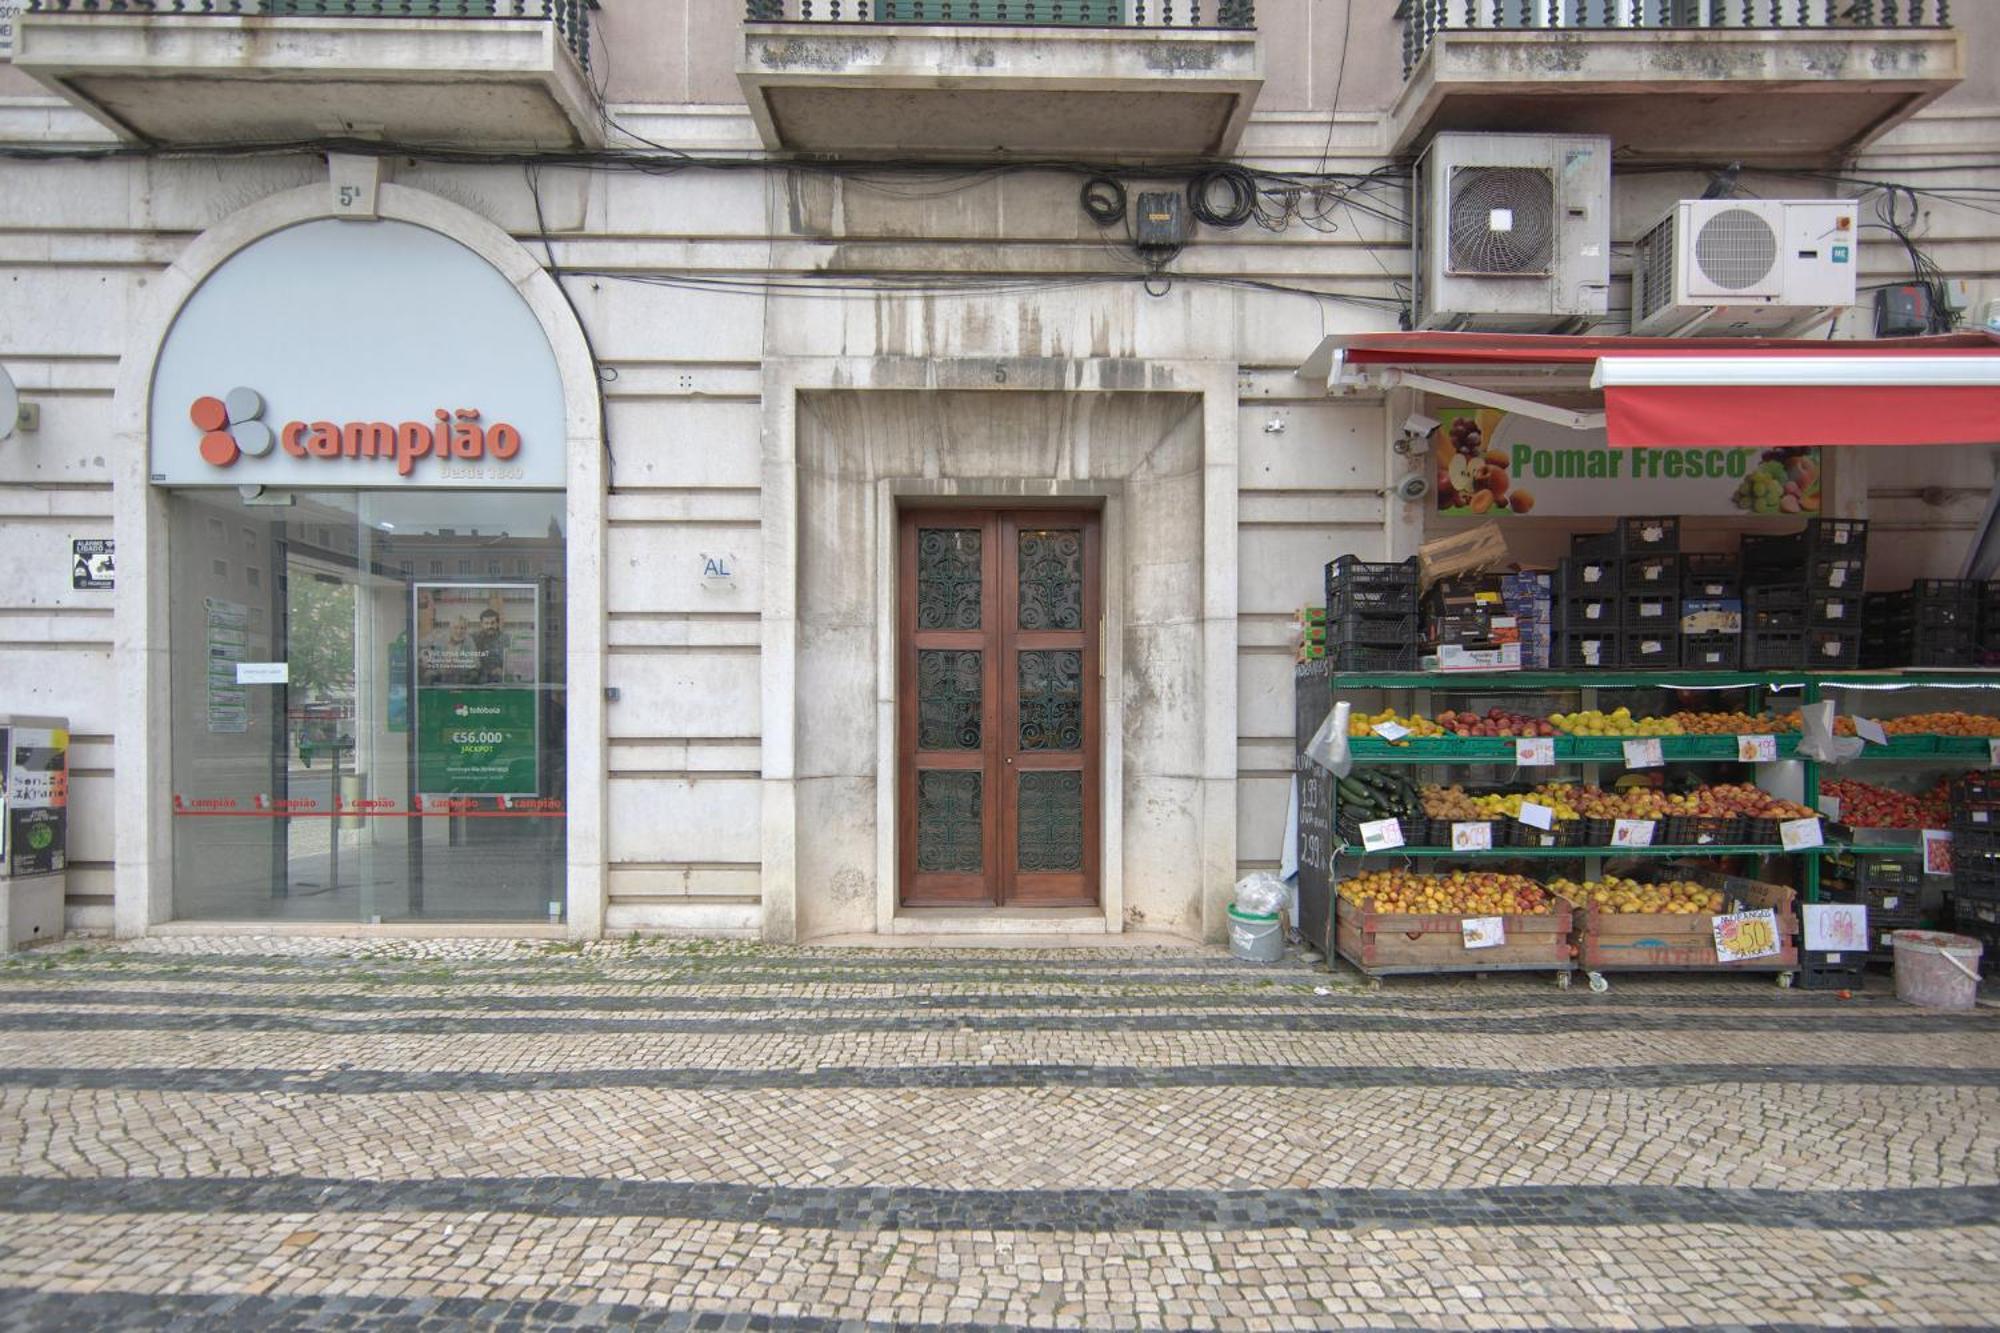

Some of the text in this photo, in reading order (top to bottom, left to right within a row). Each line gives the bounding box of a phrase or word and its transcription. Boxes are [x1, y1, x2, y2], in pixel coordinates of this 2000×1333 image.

[995, 363, 1008, 384] 5
[281, 409, 521, 477] campião
[1511, 443, 1747, 478] Pomar Fresco
[704, 558, 731, 576] AL
[452, 732, 503, 744] €56.000
[461, 745, 493, 754] JACKPOT
